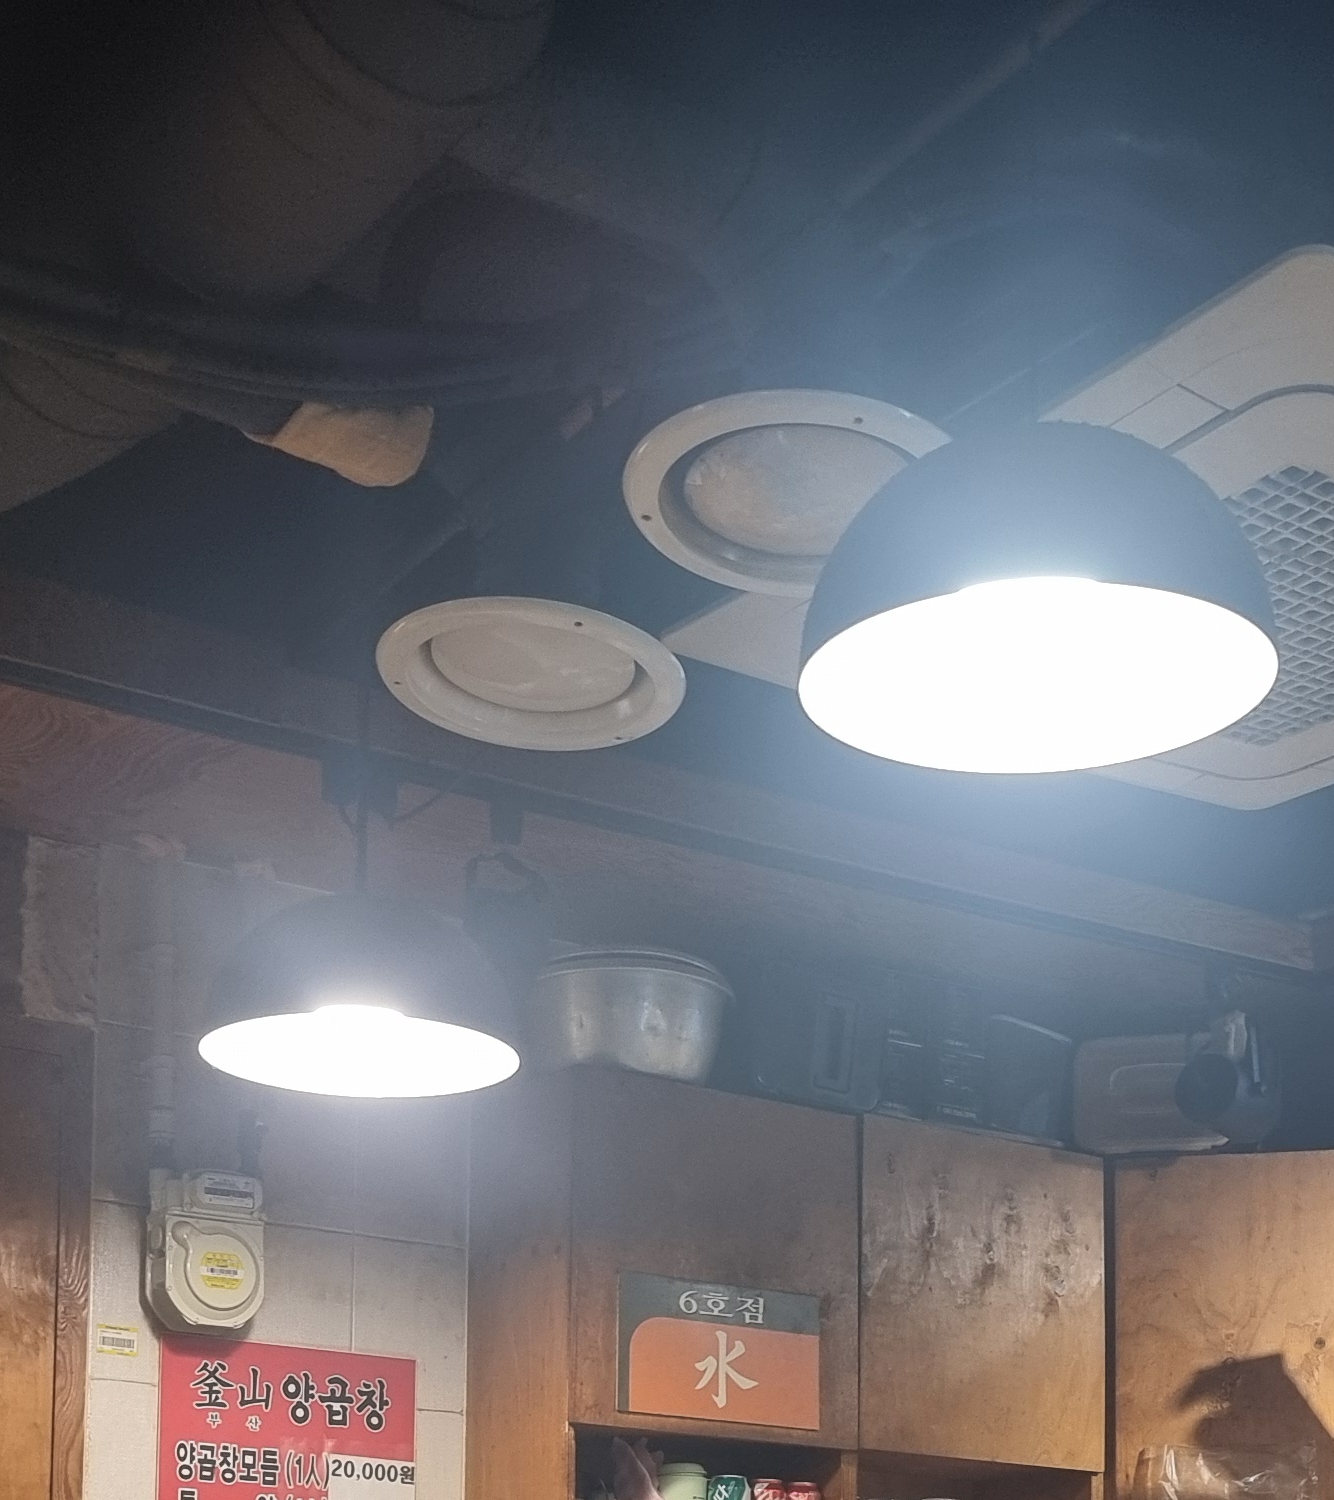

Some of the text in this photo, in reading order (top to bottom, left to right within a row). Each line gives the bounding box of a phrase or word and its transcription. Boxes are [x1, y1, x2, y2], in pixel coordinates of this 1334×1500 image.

[678, 1290, 765, 1325] 6호점
[693, 1330, 760, 1409] 水
[280, 1371, 392, 1432] 양곱창
[175, 1440, 281, 1486] 양곱창모듬
[331, 1459, 415, 1485] 20,000원
